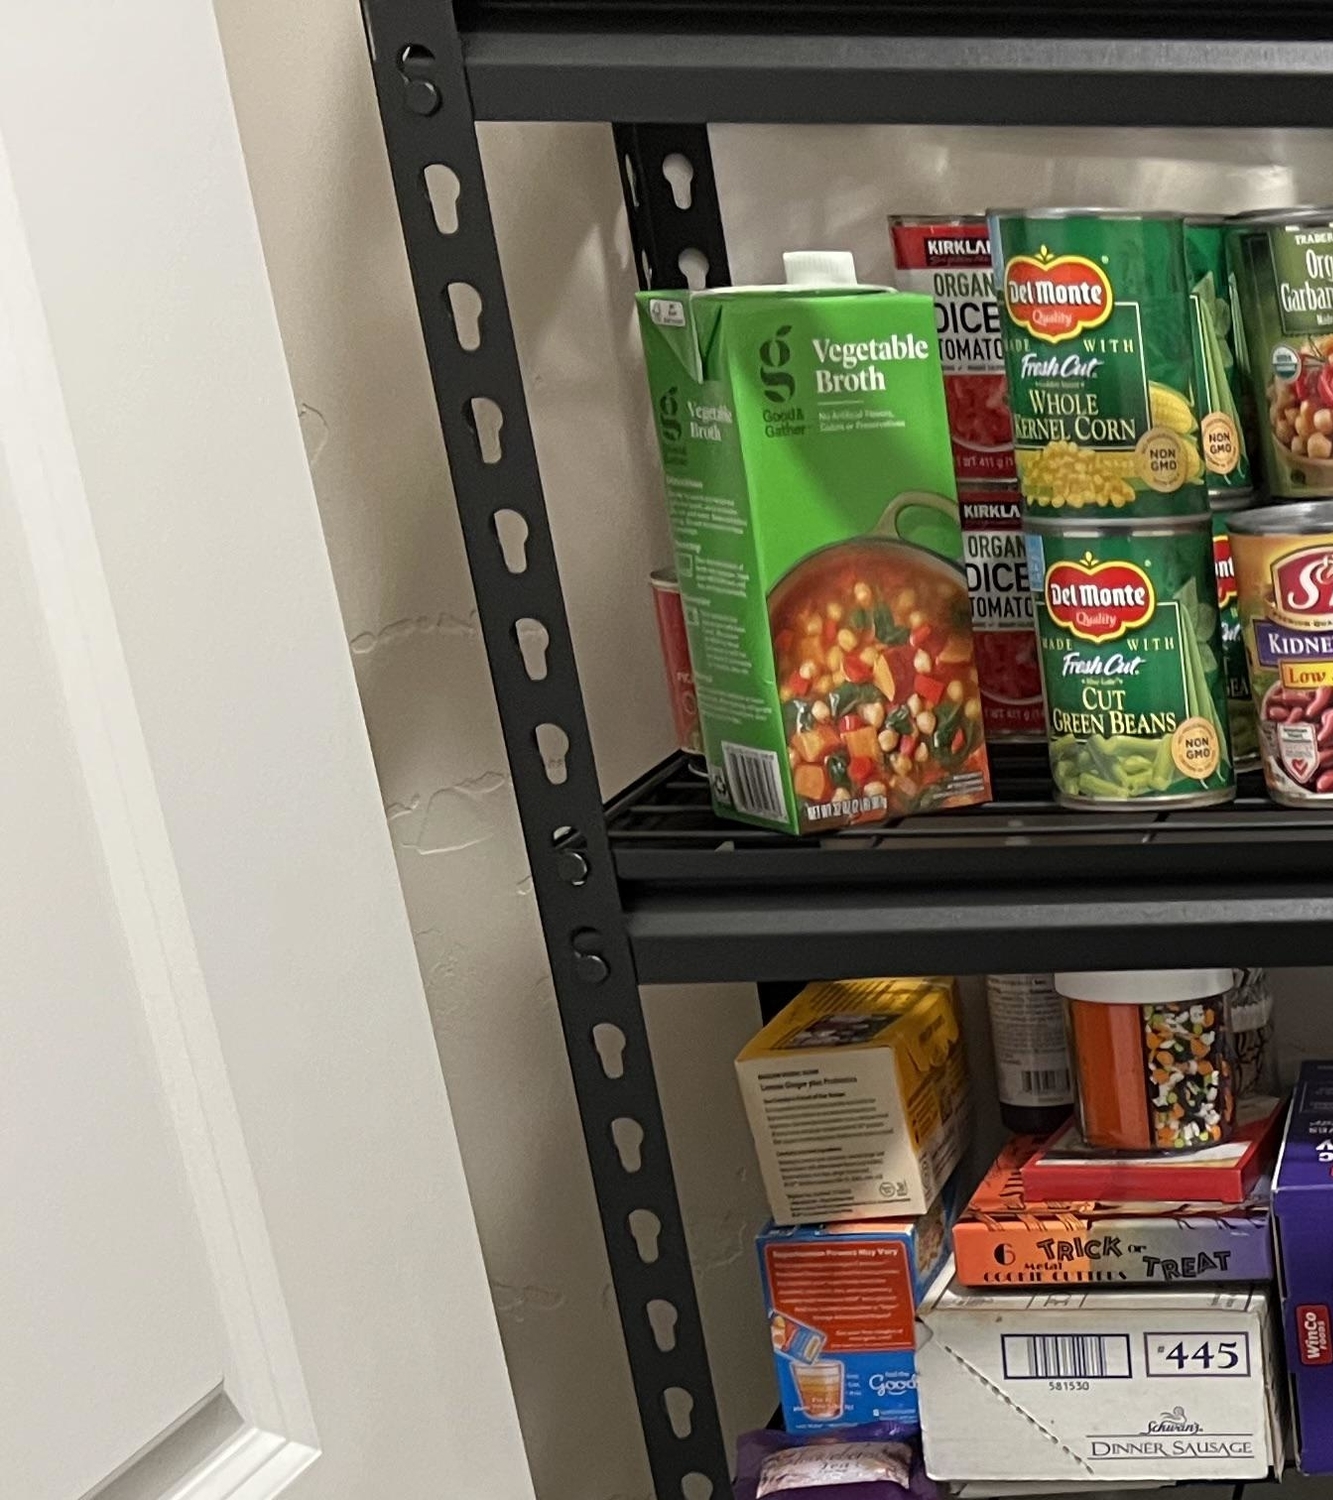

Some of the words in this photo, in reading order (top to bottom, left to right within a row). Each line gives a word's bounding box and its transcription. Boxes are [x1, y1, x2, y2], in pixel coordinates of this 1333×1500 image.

[1294, 232, 1333, 245] TRADER
[1008, 281, 1033, 304] Del
[1035, 281, 1102, 305] Monte
[1032, 309, 1073, 326] Quality
[812, 332, 929, 369] Vegetable
[1083, 339, 1134, 353] WITH
[1020, 353, 1061, 379] Fresh
[1061, 355, 1104, 378] Cut
[816, 366, 886, 394] Broth
[1029, 389, 1099, 415] WHOLE
[765, 424, 806, 438] Gather
[1015, 416, 1068, 441] KERNEL
[1075, 413, 1136, 441] CORN
[1208, 431, 1231, 443] NON
[1150, 448, 1176, 459] NON
[1210, 442, 1233, 454] GMO
[1151, 459, 1177, 472] GMO
[1051, 584, 1076, 605] Del
[1080, 584, 1145, 607] Monte
[1076, 611, 1117, 628] Quality
[1126, 638, 1175, 651] WITH
[1062, 652, 1103, 676] Fresh
[1288, 665, 1327, 684] Low
[1082, 687, 1126, 711] CUT
[1053, 709, 1104, 735] GREEN
[1110, 709, 1176, 735] BEANS
[1185, 737, 1209, 749] NON
[1186, 748, 1210, 760] GMO
[994, 1242, 1016, 1266] 6
[1037, 1235, 1122, 1262] TRICK
[1142, 1251, 1231, 1282] TREAT
[983, 1271, 1043, 1282] COOKIE
[1304, 1312, 1321, 1359] WinCo
[868, 1373, 917, 1397] Good
[1048, 1381, 1090, 1392] 581530
[1090, 1440, 1165, 1458] DINNER
[1171, 1439, 1253, 1459] SAUSAGE
